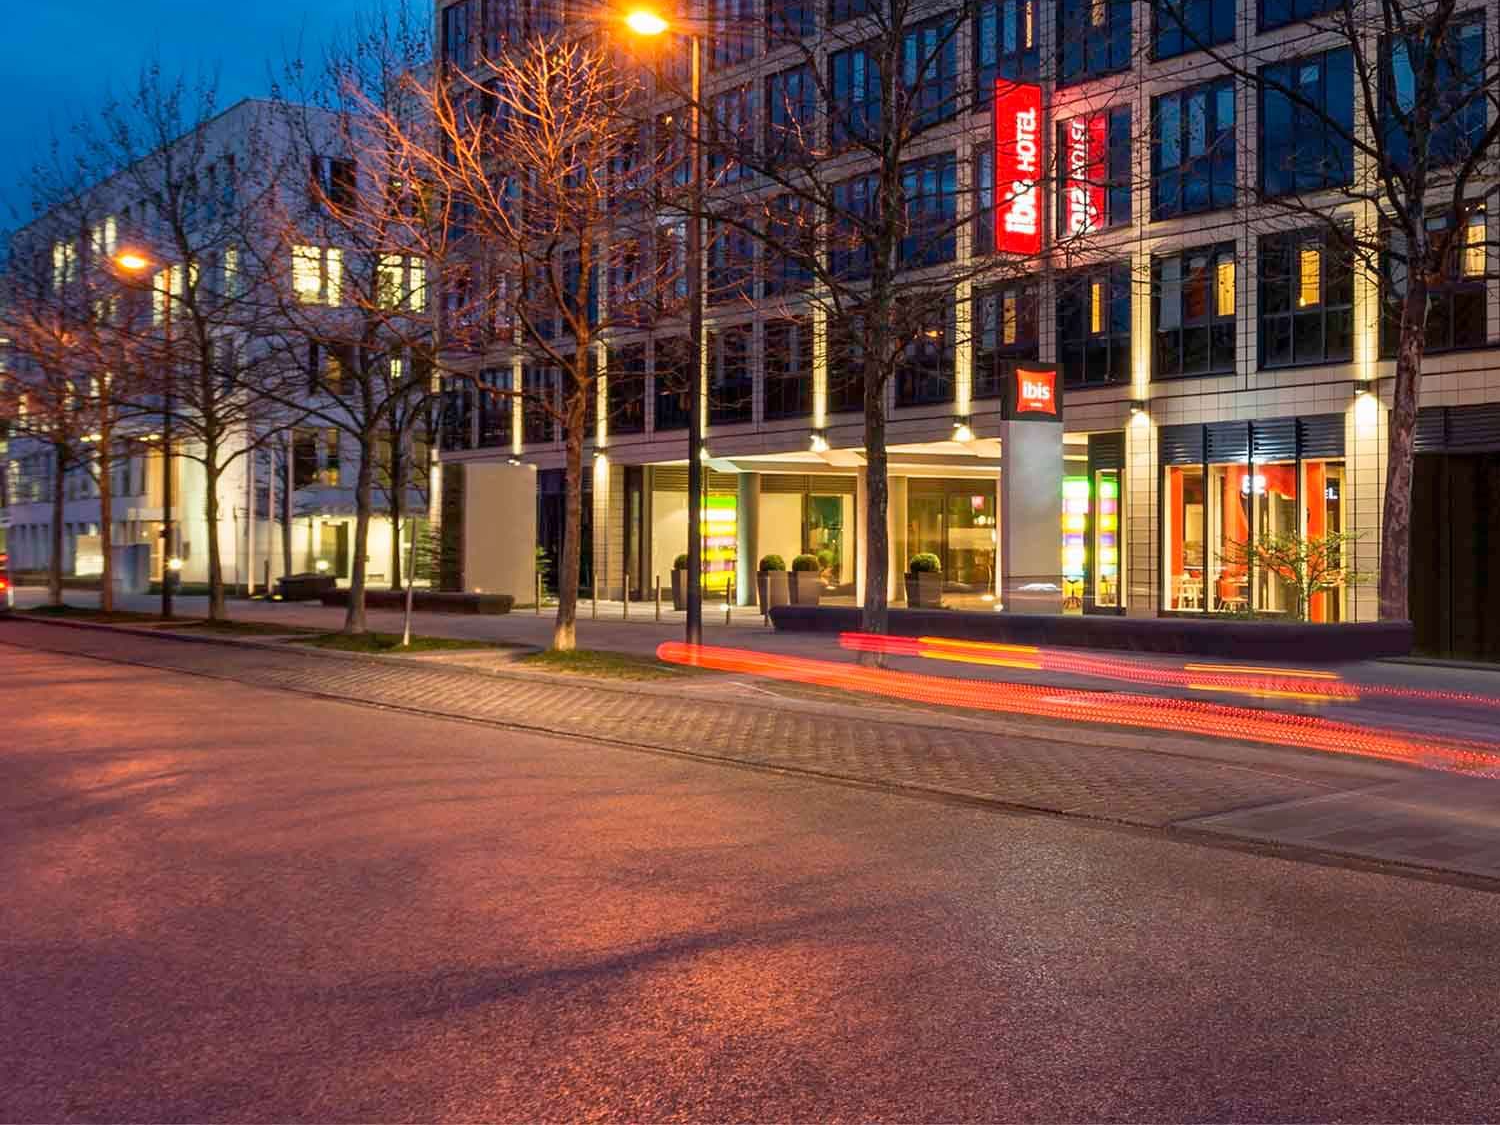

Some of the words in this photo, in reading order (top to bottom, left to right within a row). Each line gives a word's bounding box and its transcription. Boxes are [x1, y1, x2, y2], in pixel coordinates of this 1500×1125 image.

[1016, 107, 1036, 172] HOTEL
[1005, 178, 1036, 235] ibis
[1022, 380, 1050, 399] ibis
